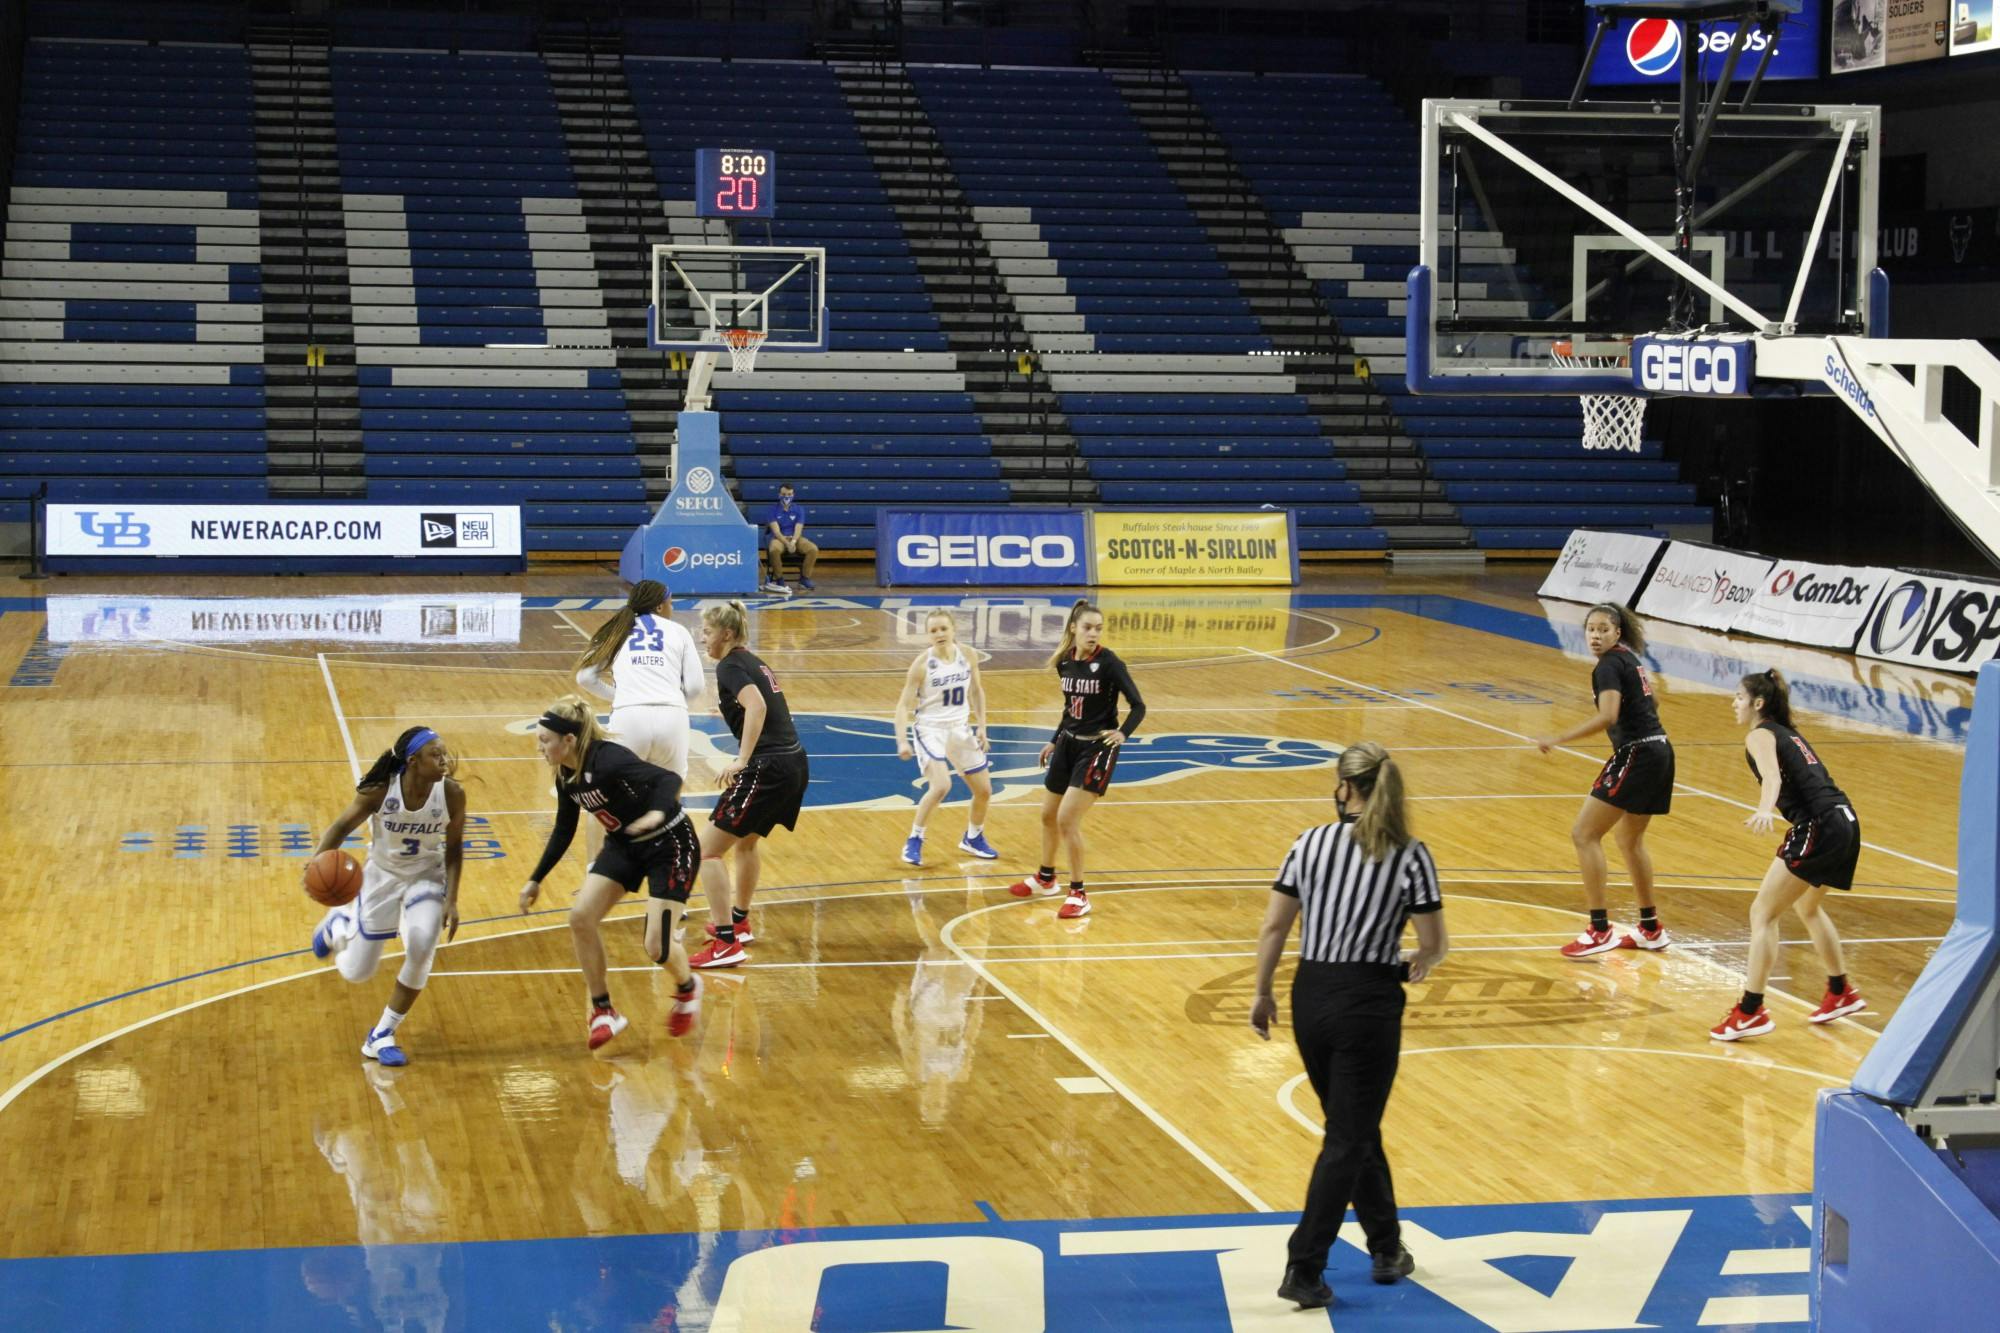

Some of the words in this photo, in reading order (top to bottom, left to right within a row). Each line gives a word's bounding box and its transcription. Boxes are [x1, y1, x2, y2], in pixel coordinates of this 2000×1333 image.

[1888, 2, 1925, 18] SOLDIERS
[721, 155, 766, 175] 8:00
[717, 176, 757, 210] 20
[1641, 343, 1737, 394] GEICO
[675, 496, 723, 510] SEFCU
[191, 519, 382, 542] NEWERACAP.COM
[462, 520, 489, 530] NEW
[1122, 522, 1160, 533] Buffalo's
[1162, 522, 1213, 533] Steakhouse
[1215, 522, 1239, 532] Since
[462, 530, 489, 541] ERA
[690, 550, 741, 569] pepsi
[897, 534, 1076, 568] GEICO
[1123, 566, 1158, 576] Corner
[1168, 566, 1196, 576] Maple
[1207, 566, 1234, 576] North
[1236, 566, 1264, 576] Bailey
[1655, 566, 1713, 594] BALANCED
[1792, 573, 1870, 605] ComDoc
[628, 628, 664, 651] 23
[631, 655, 664, 667] WALTERS
[1075, 678, 1101, 694] STATE
[943, 686, 964, 706] 10
[400, 838, 420, 856] 3
